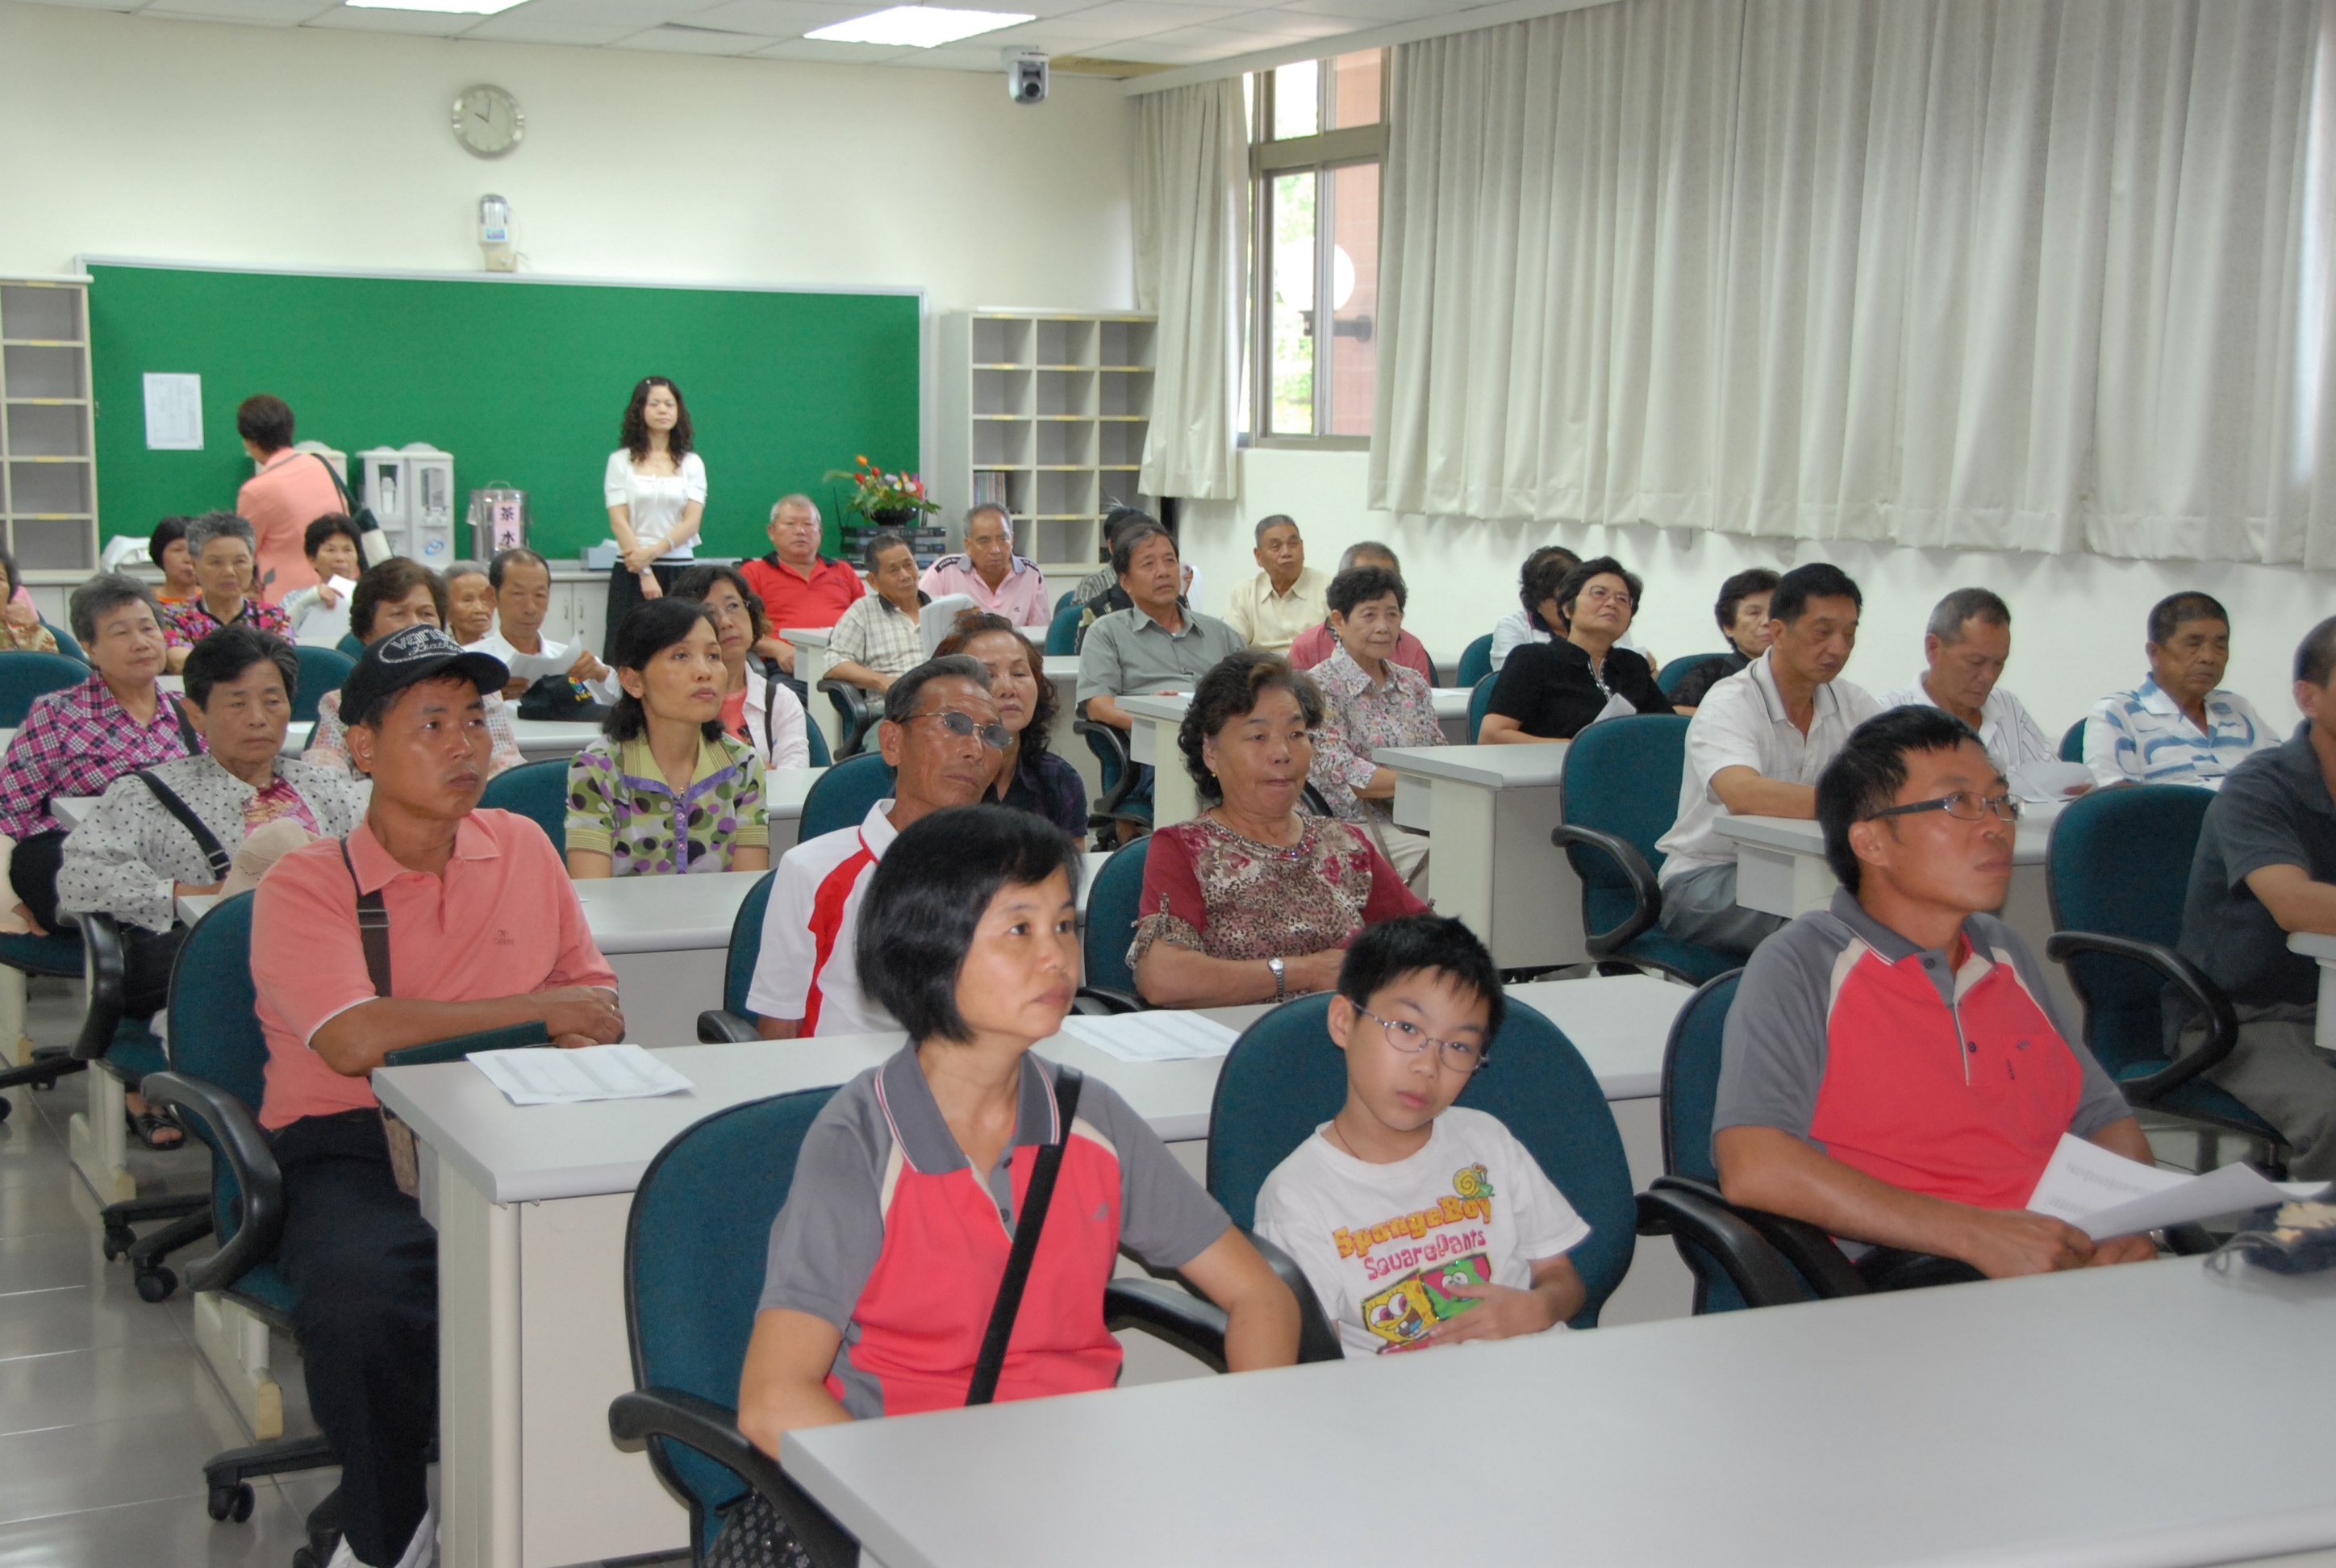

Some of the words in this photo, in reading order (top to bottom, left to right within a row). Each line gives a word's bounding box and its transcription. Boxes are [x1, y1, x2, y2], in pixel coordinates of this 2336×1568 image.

[501, 506, 515, 545] 茶水
[1332, 1195, 1491, 1259] SpongeBoy
[1363, 1228, 1487, 1281] SquarePants
